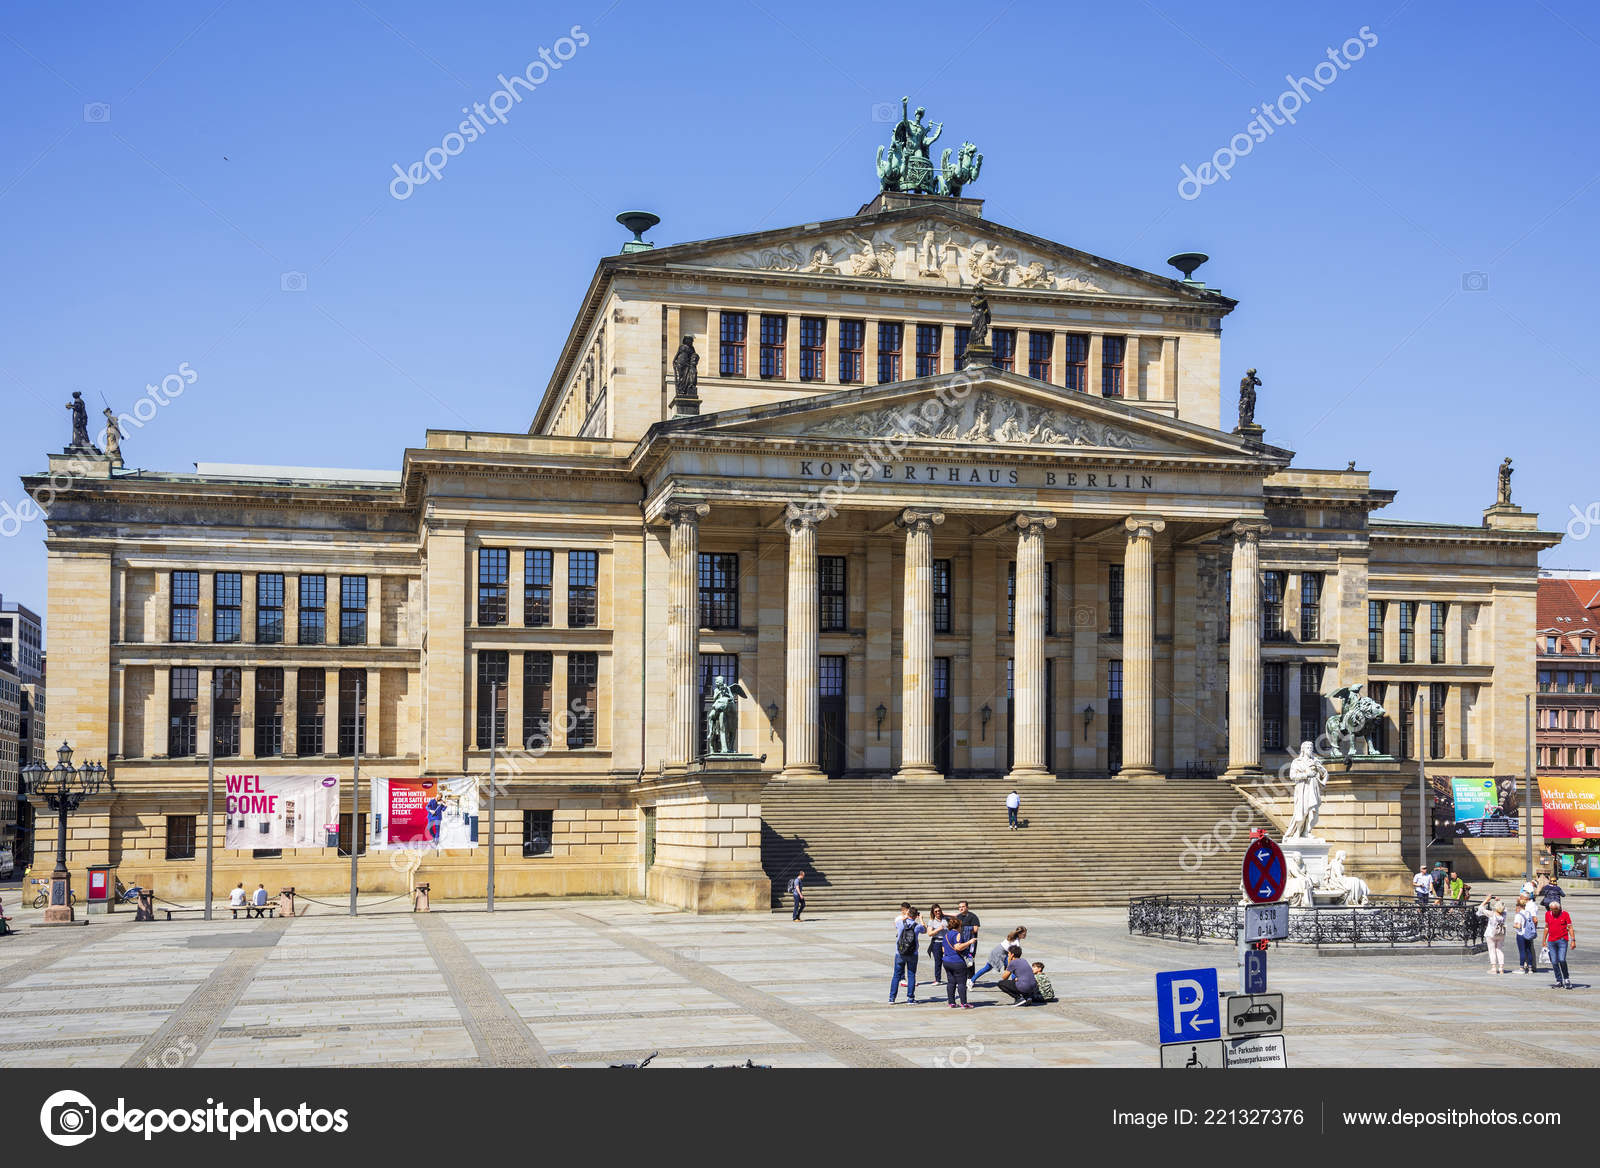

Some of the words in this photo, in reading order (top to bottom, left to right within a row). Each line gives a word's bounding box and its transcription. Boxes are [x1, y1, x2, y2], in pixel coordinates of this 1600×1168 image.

[800, 461, 1018, 484] KONZERTHAUS
[1046, 471, 1153, 489] BERLIN
[226, 775, 264, 793] WEL
[1542, 789, 1564, 799] Mehr
[1566, 789, 1578, 799] als
[1579, 790, 1595, 799] eine
[226, 795, 278, 814] COME
[1171, 979, 1204, 1034] P
[1238, 1044, 1264, 1055] Parkschein
[1264, 1043, 1278, 1052] oder
